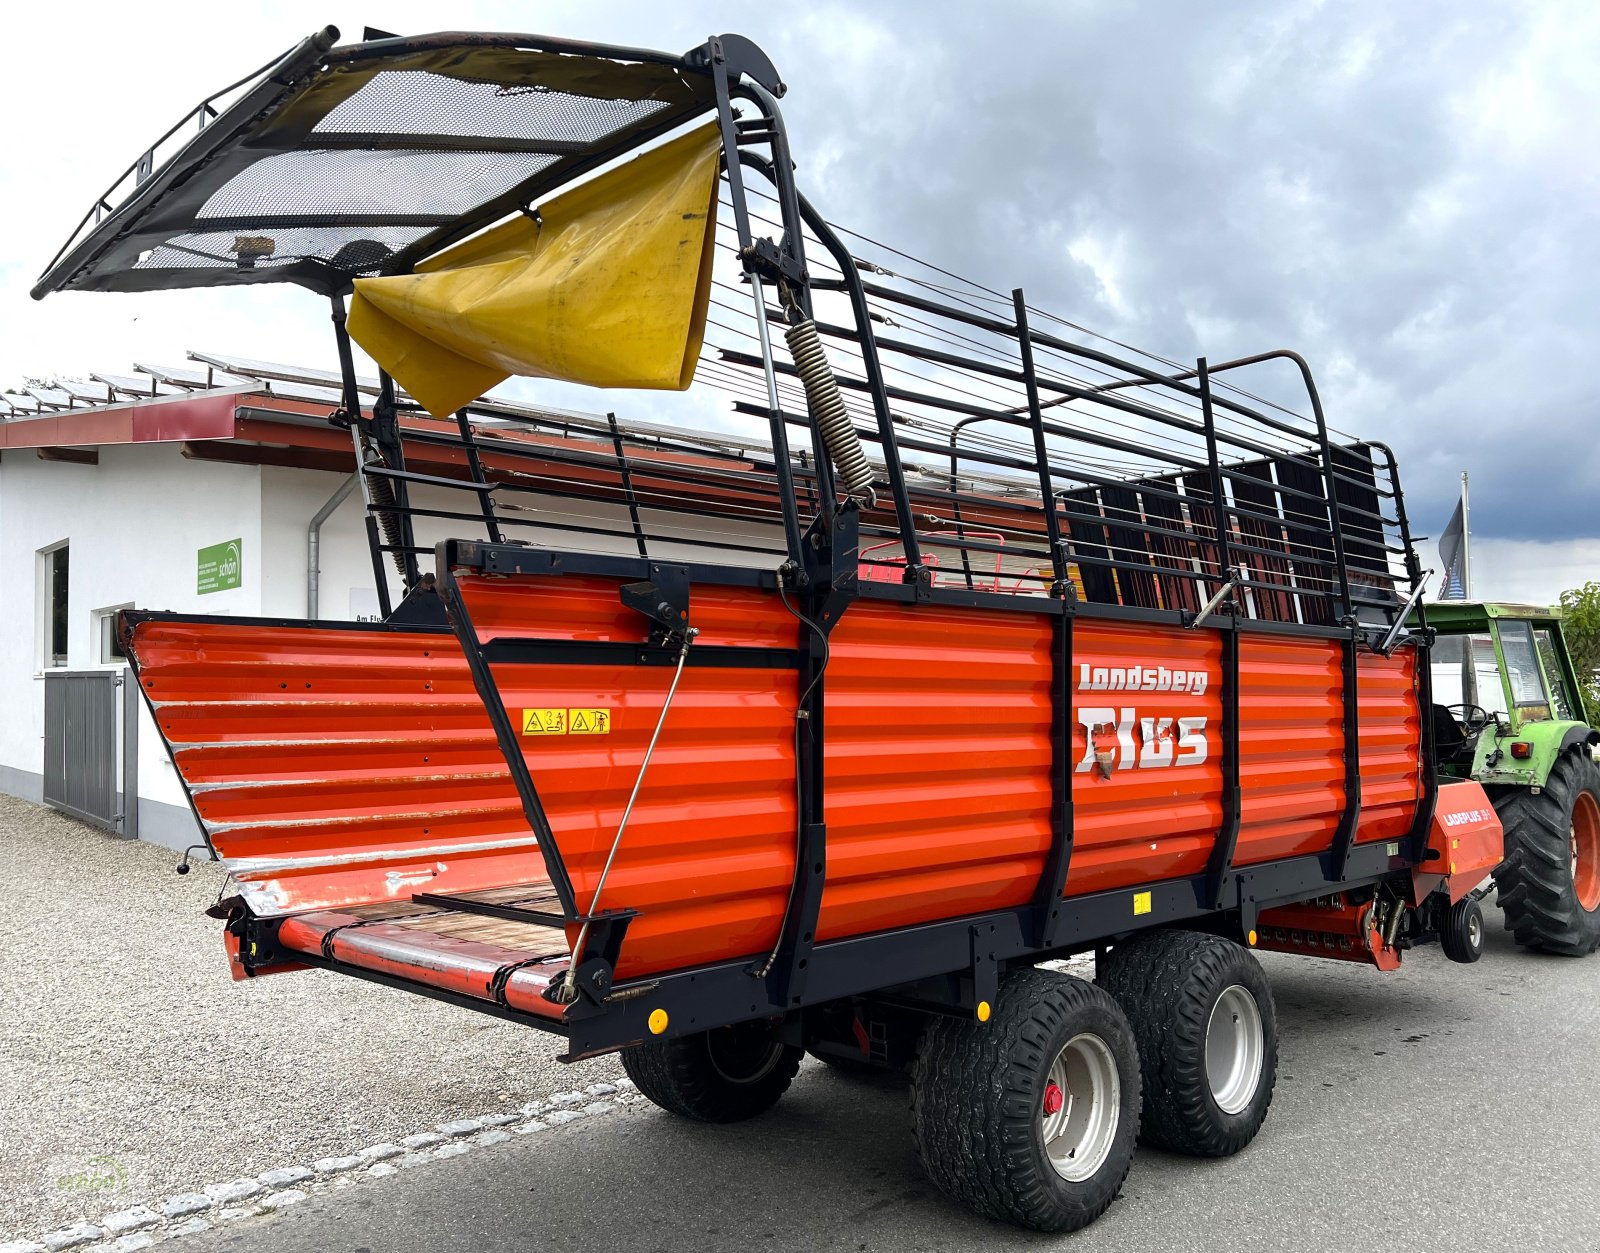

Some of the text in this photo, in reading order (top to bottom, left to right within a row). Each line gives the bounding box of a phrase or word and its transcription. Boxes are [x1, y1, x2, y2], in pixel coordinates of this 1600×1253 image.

[219, 557, 236, 577] schön
[356, 614, 384, 623] Am Flu
[1077, 663, 1208, 696] Landsberg
[1443, 810, 1482, 827] LADEPLUS
